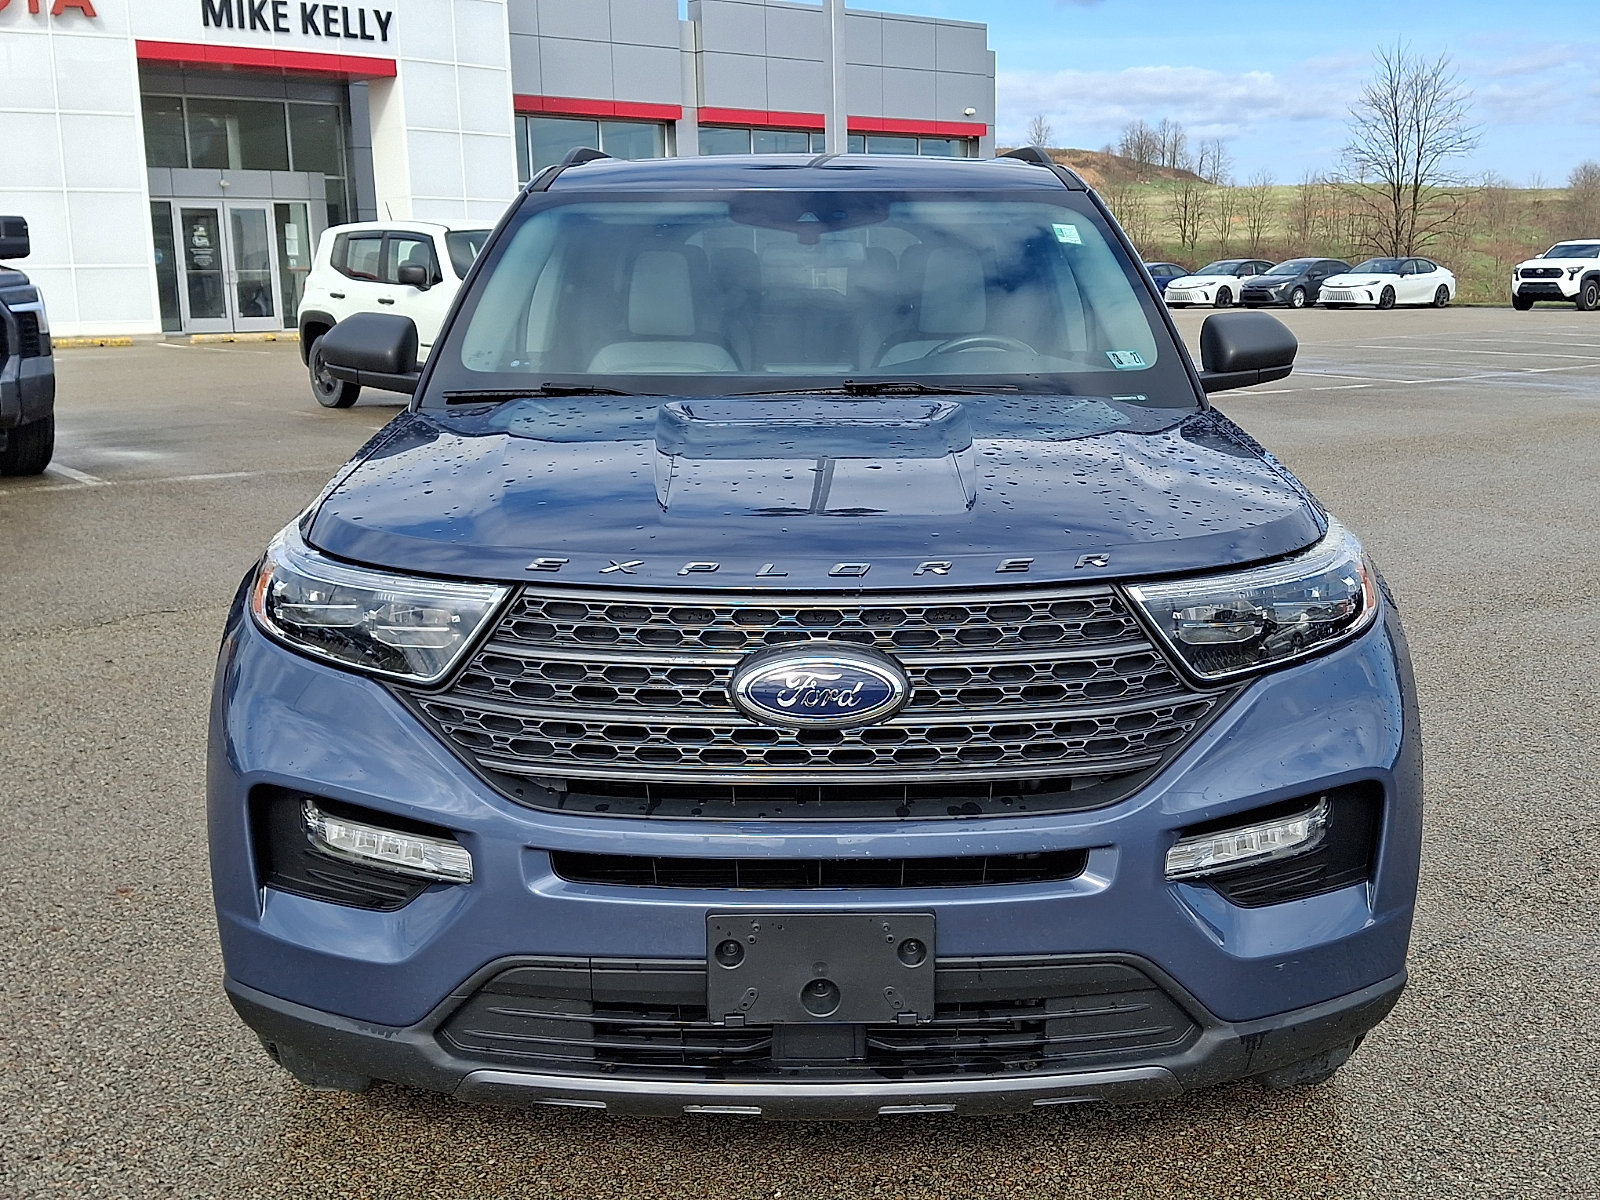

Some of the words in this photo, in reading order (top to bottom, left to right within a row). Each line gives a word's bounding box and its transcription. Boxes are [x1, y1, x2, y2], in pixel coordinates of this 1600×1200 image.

[201, 0, 290, 33] MIKE
[300, 2, 392, 42] KELLY
[525, 553, 1110, 577] EXPLORER
[776, 670, 864, 708] Ford
